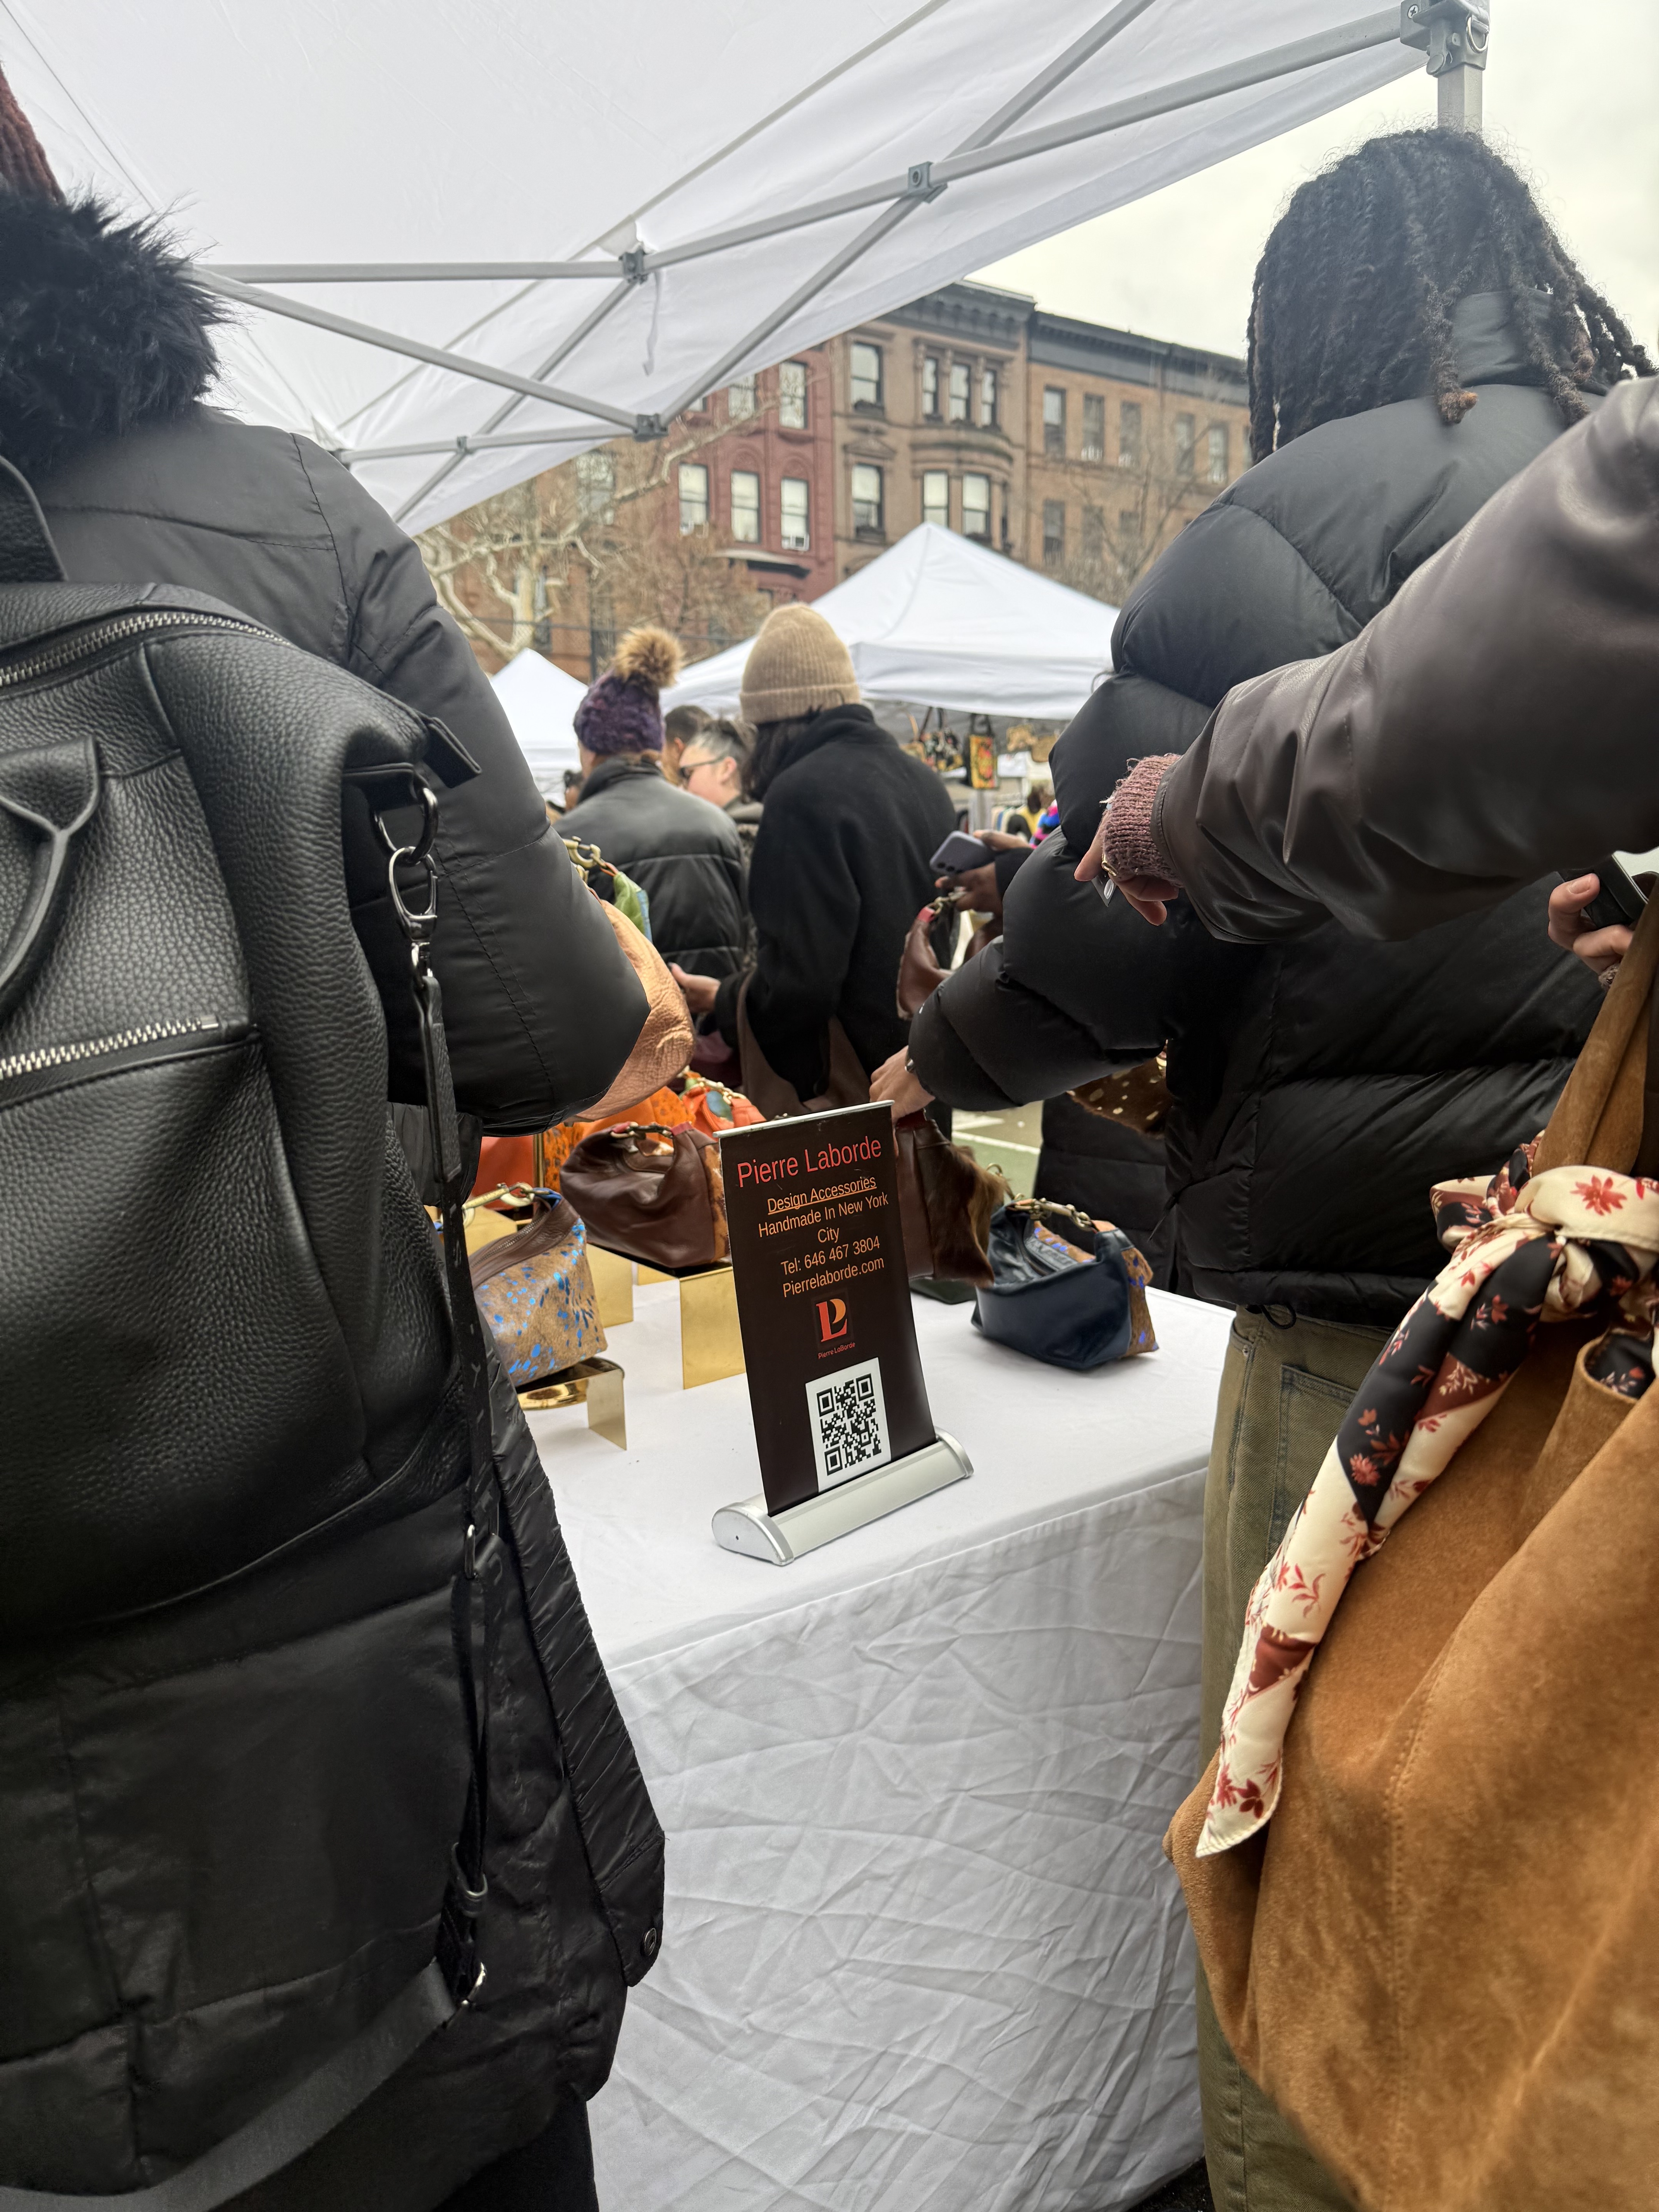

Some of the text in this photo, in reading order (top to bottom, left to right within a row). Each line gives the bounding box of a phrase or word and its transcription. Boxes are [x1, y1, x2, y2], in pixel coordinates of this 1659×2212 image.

[737, 1136, 881, 1188] Pierre Laborde
[758, 1192, 888, 1238] Handmade In New York
[768, 1176, 876, 1214] Design Accessories
[781, 1235, 880, 1276] Tel: 646 467 3804
[817, 1227, 839, 1243] City
[783, 1257, 884, 1298] Pierrelaborde.com
[818, 1349, 834, 1359] Pierre
